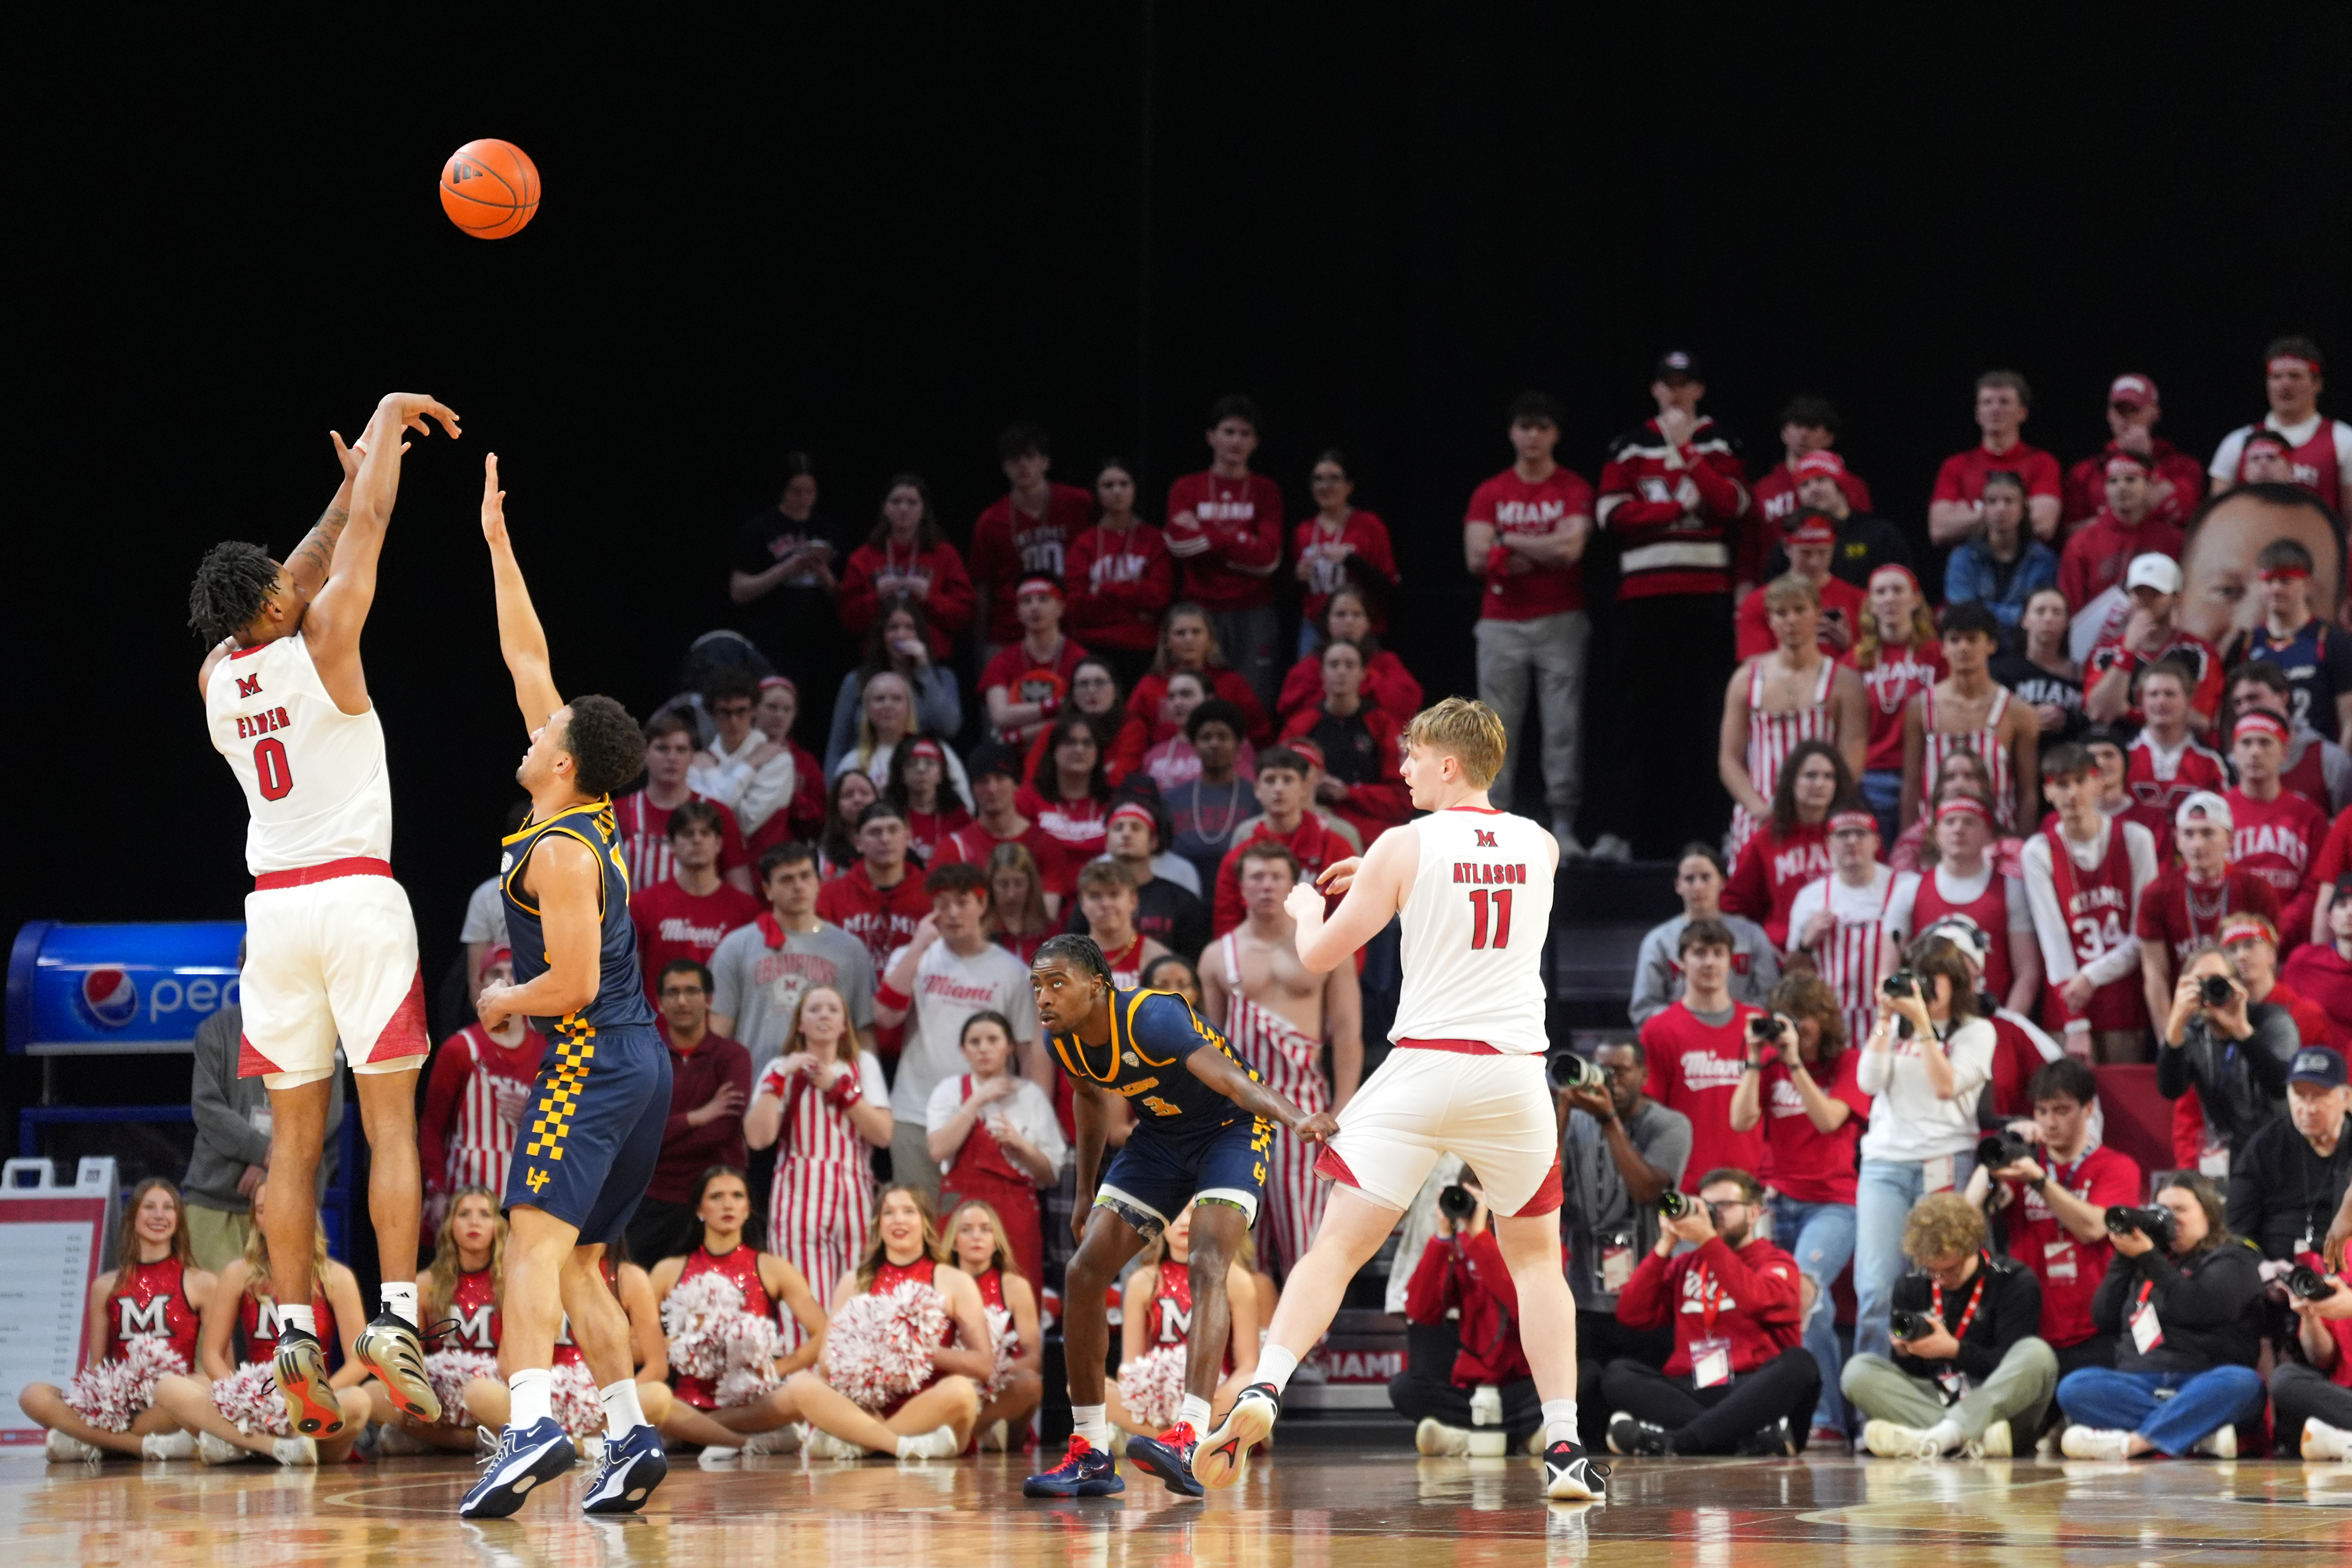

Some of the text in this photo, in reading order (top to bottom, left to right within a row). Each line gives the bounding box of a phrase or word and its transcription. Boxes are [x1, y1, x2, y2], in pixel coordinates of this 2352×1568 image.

[235, 673, 263, 699] M
[253, 737, 294, 802] 0
[1474, 829, 1499, 847] M
[1453, 863, 1526, 884] ATLASON
[1469, 889, 1512, 950] 11
[2072, 910, 2130, 960] 34
[118, 1294, 173, 1340] M
[442, 1304, 497, 1348] M
